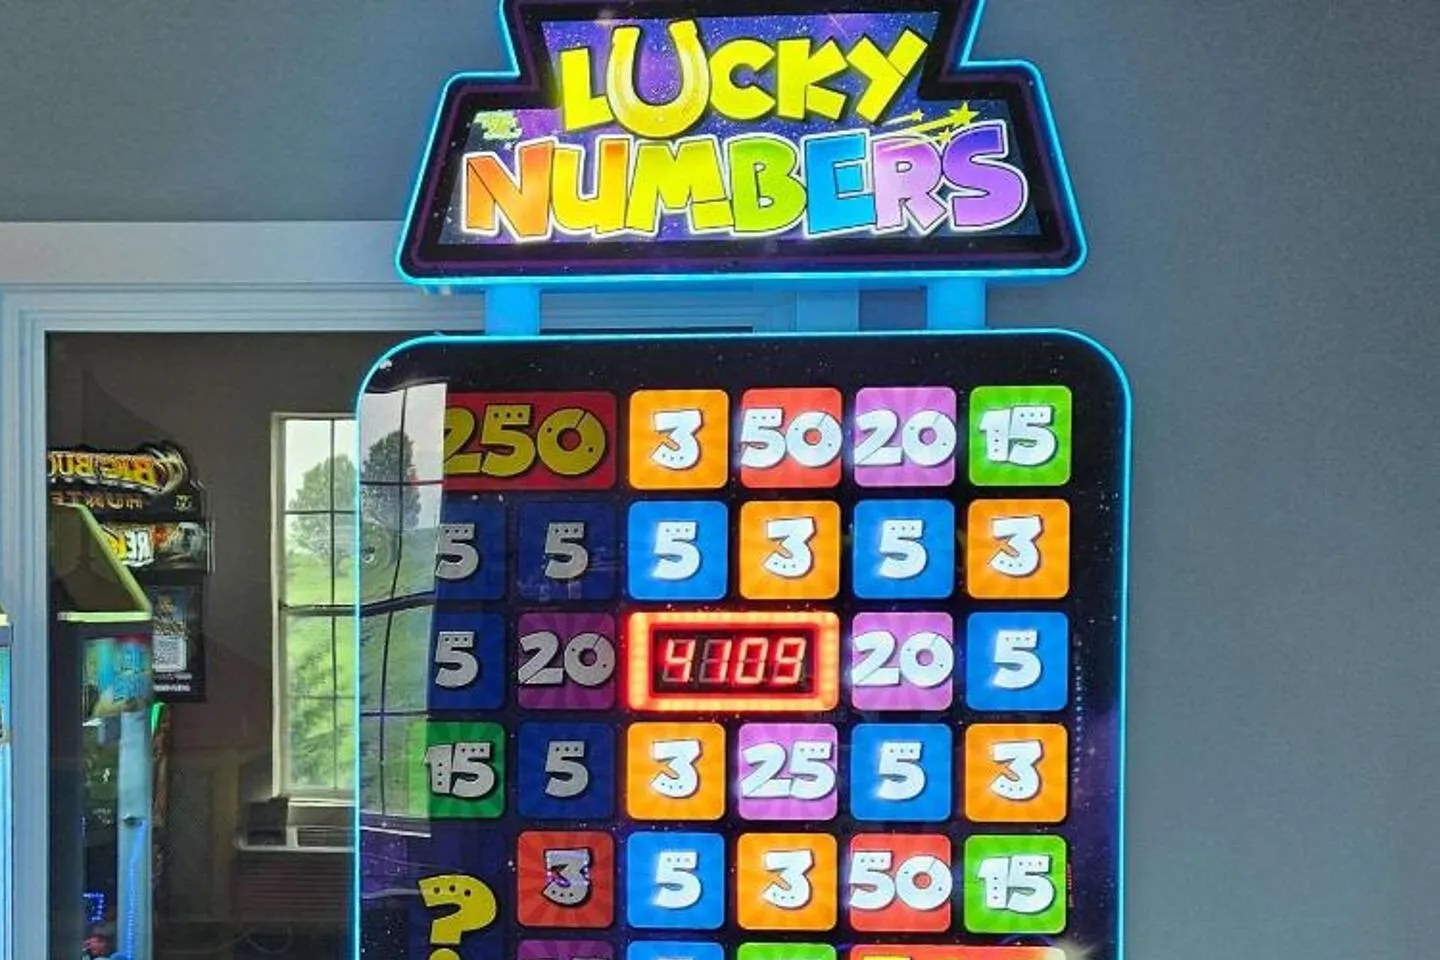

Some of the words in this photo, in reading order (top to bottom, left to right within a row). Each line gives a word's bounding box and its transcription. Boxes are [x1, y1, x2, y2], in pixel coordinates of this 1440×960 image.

[560, 20, 928, 138] LUCKY
[464, 120, 1029, 240] NUMBERS
[443, 404, 606, 477] 250
[650, 408, 702, 471] 3
[741, 406, 843, 467] 50
[852, 408, 957, 467] 20
[978, 404, 1057, 465] 15
[435, 522, 480, 580] 5
[544, 521, 589, 579] 5
[653, 520, 698, 578] 5
[762, 517, 816, 578] 3
[876, 519, 925, 577] 5
[986, 515, 1044, 577] 3
[434, 630, 479, 688] 5
[517, 631, 616, 687] 20
[663, 637, 806, 684] 4109
[851, 630, 955, 687] 20
[991, 629, 1039, 687] 5
[423, 739, 496, 798] 15
[544, 740, 589, 797] 5
[650, 739, 703, 798] 3
[741, 739, 838, 799] 25
[875, 739, 927, 800] 5
[986, 739, 1042, 801] 3
[541, 848, 594, 907] 3
[653, 849, 702, 909] 5
[762, 849, 816, 910] 3
[848, 850, 953, 911] 50
[977, 852, 1054, 913] 15
